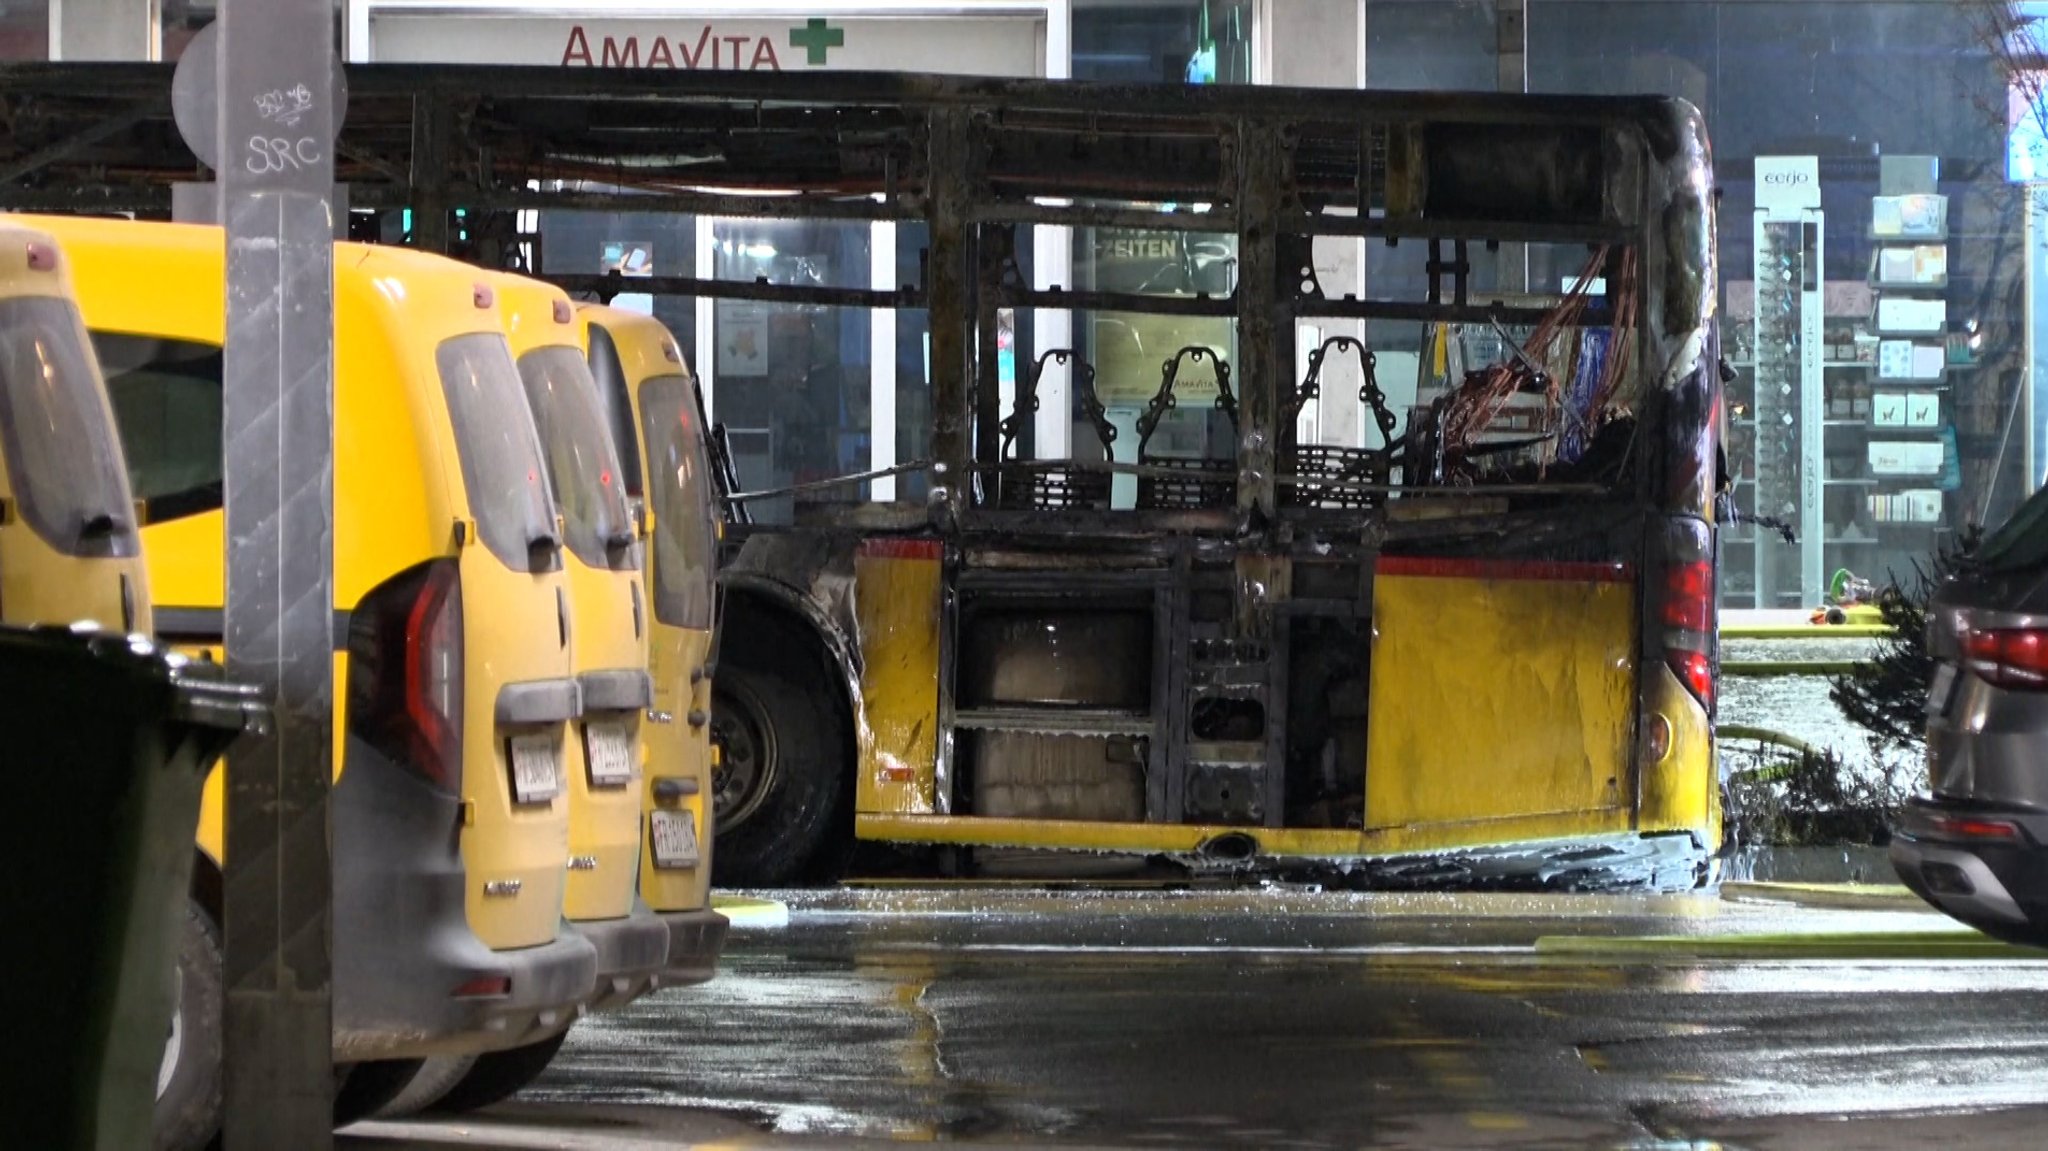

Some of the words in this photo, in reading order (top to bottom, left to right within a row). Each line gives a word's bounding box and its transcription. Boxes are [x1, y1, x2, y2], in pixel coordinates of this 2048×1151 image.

[560, 25, 781, 70] AMAVITA
[246, 136, 320, 173] SRC
[1102, 239, 1177, 257] ZEITEN
